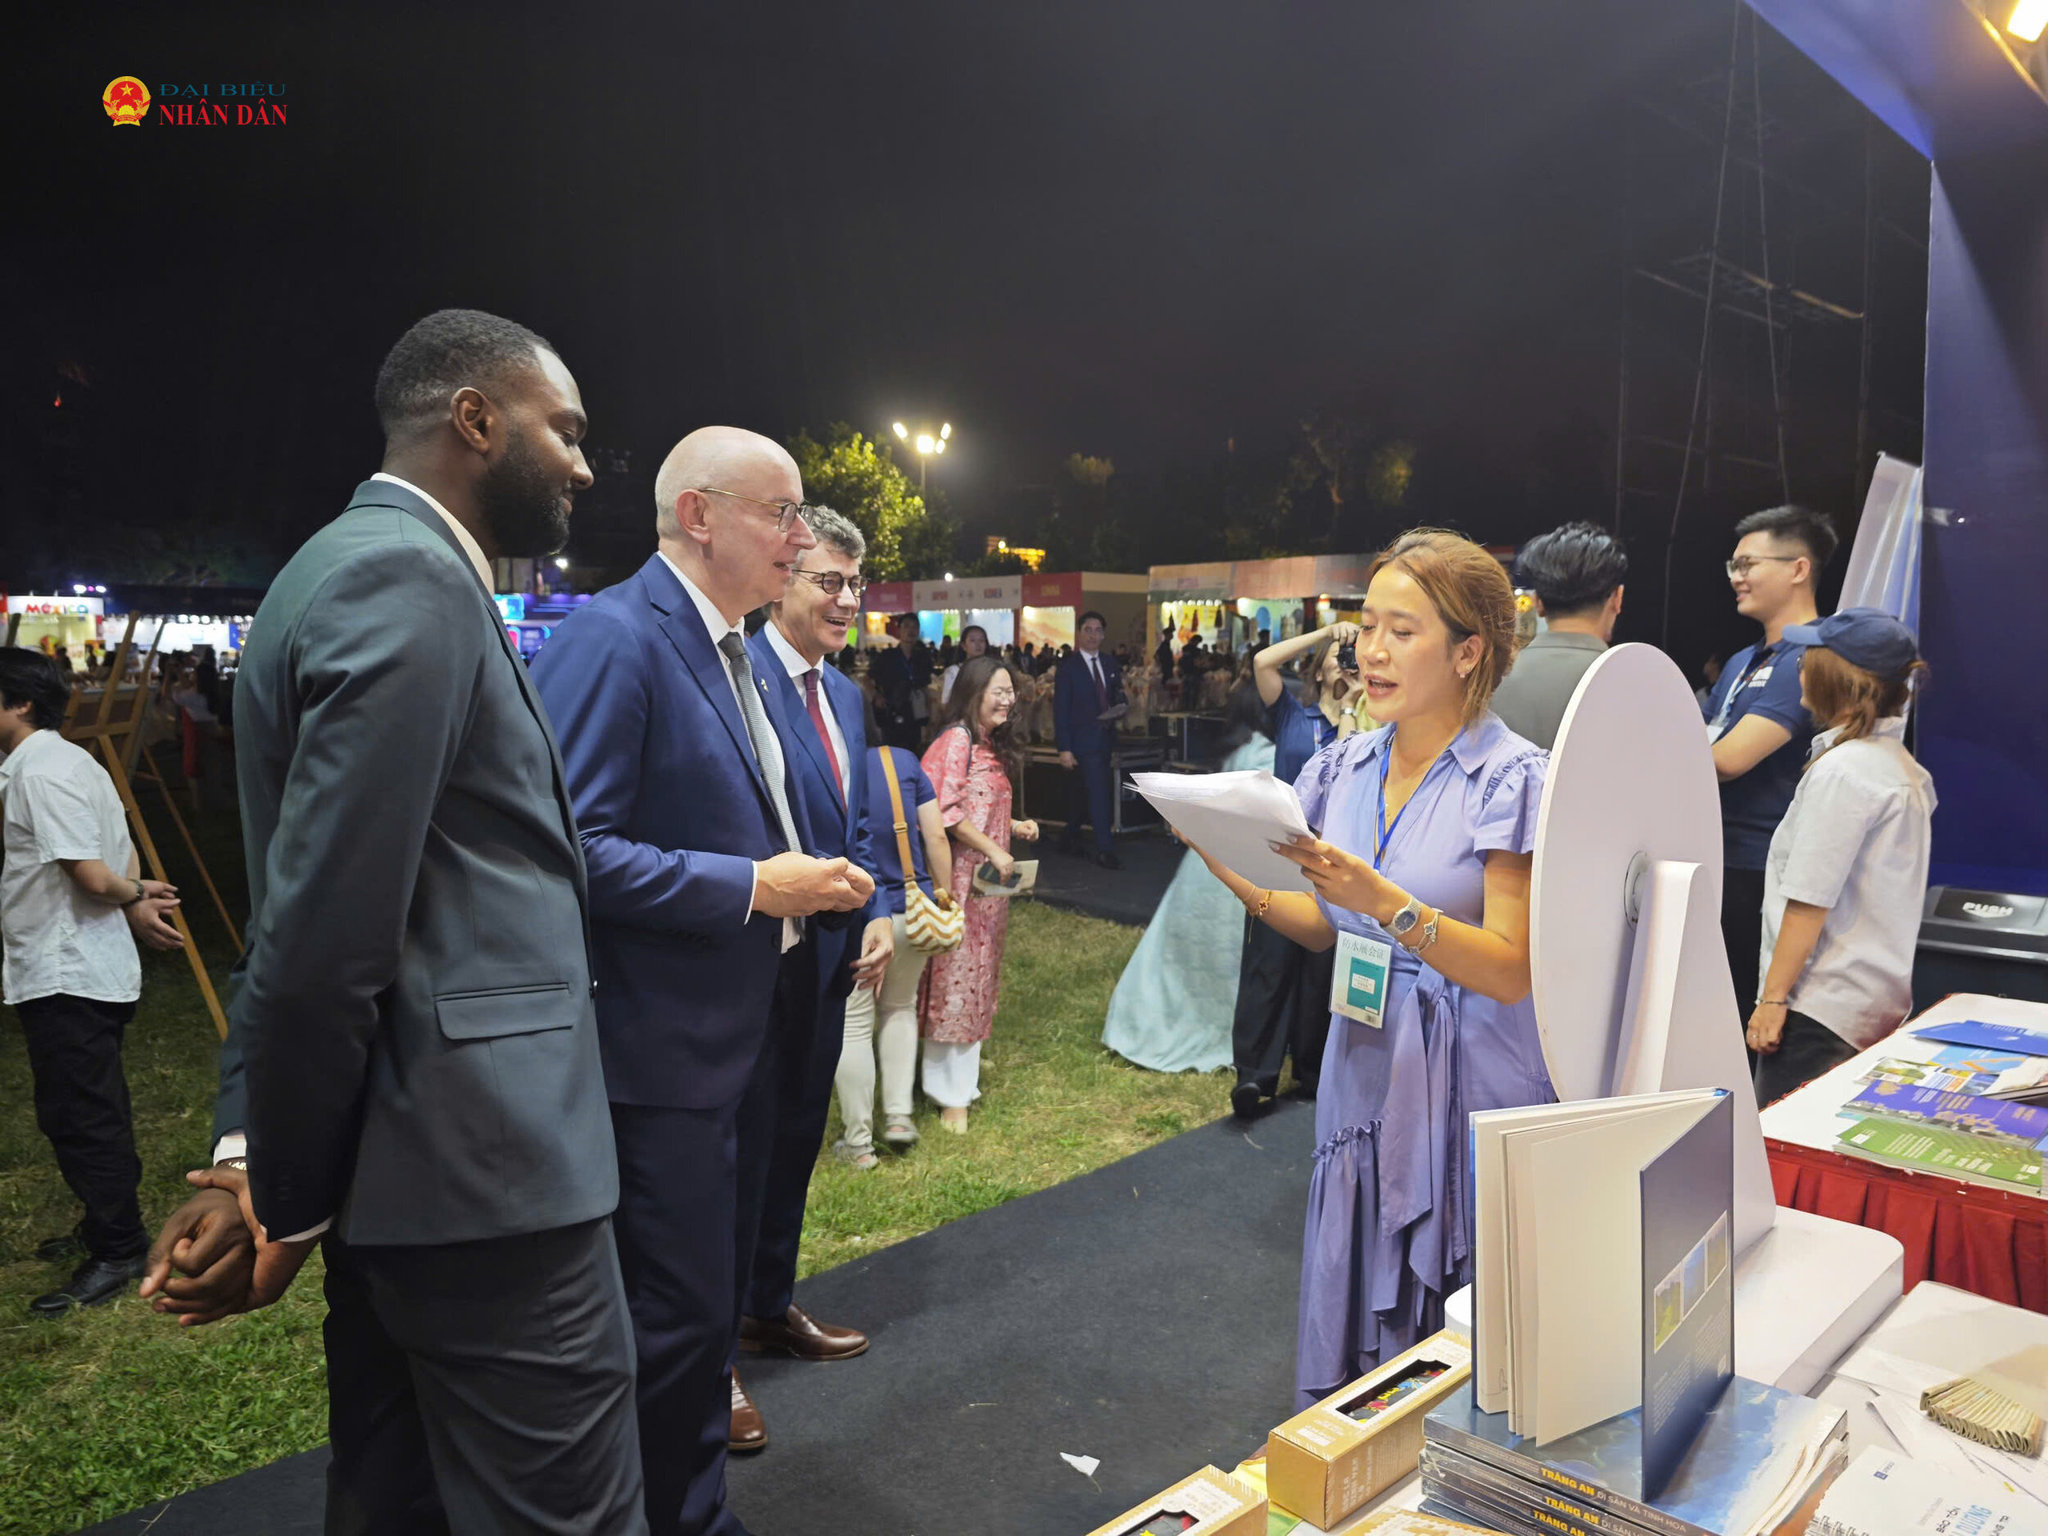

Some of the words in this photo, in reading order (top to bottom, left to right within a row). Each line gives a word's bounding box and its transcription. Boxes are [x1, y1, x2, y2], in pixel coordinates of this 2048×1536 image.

[1578, 1482, 1595, 1496] AN
[1642, 1508, 1665, 1523] TINH
[1665, 1518, 1687, 1534] HOA
[1581, 1511, 1599, 1525] AN
